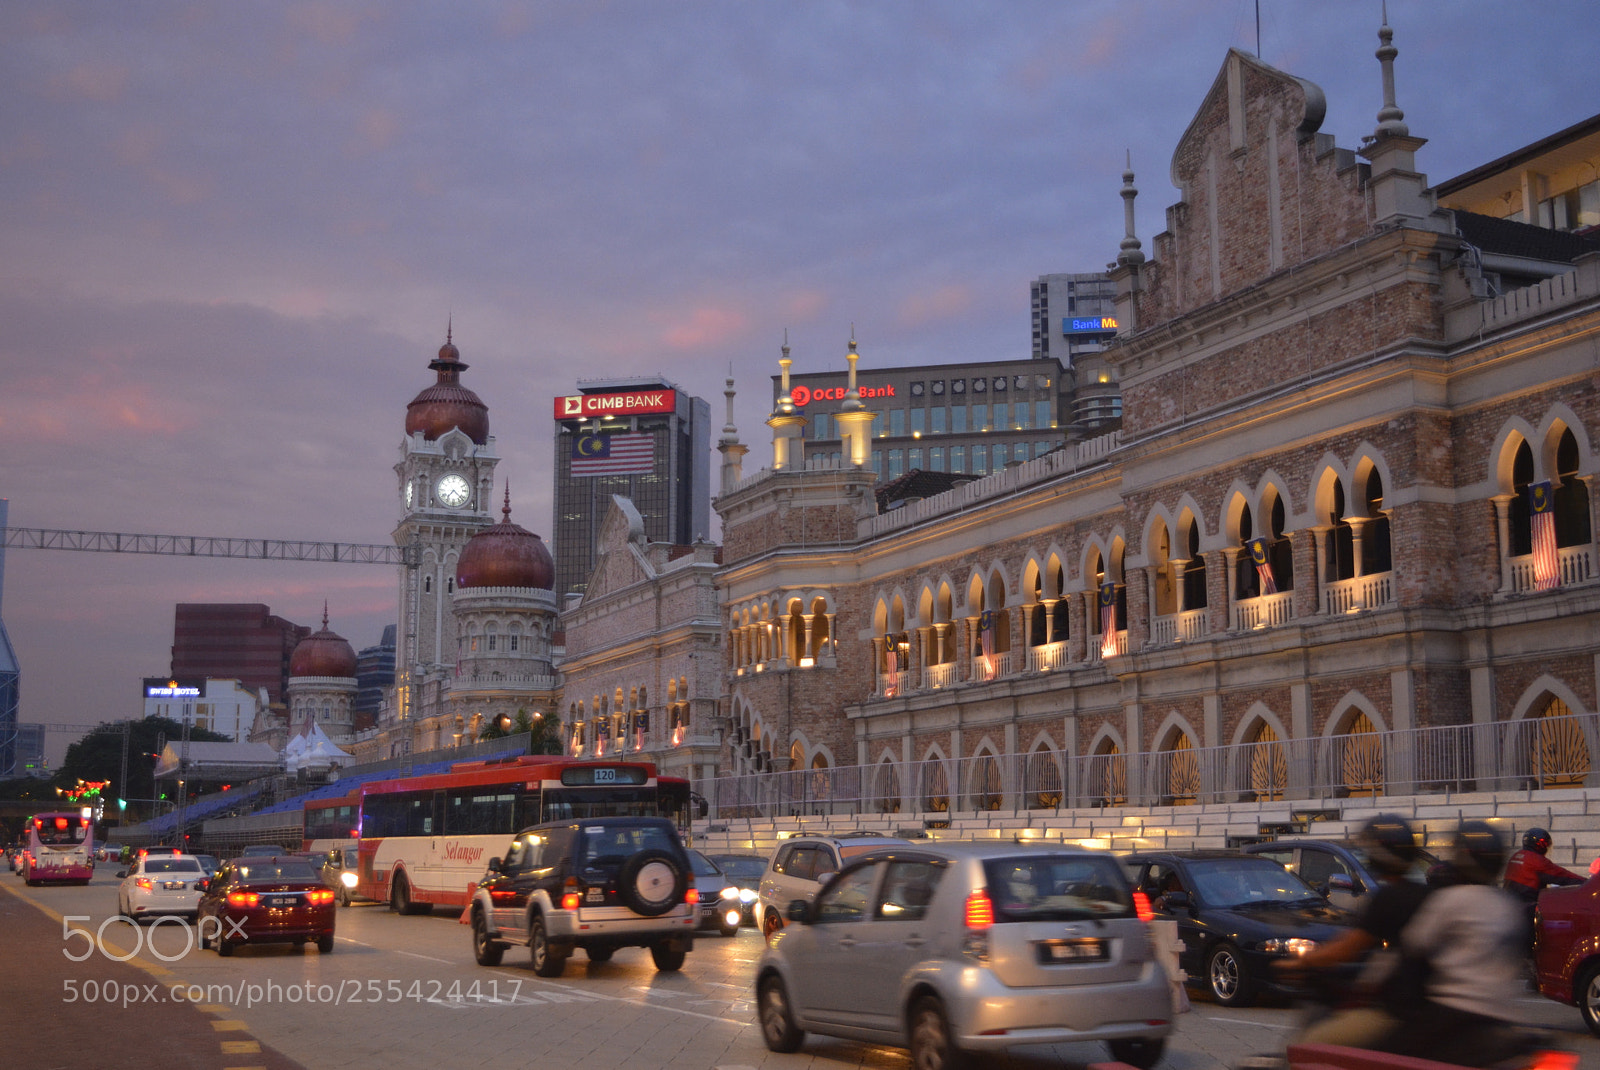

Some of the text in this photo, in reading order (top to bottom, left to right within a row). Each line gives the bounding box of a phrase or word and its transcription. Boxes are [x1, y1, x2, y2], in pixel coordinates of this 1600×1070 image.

[1072, 318, 1100, 330] Bank
[813, 384, 895, 401] OCB Bank
[587, 394, 663, 410] CIMB BANK
[149, 687, 173, 695] SWISS
[595, 770, 614, 780] 120
[443, 841, 484, 865] Selangor
